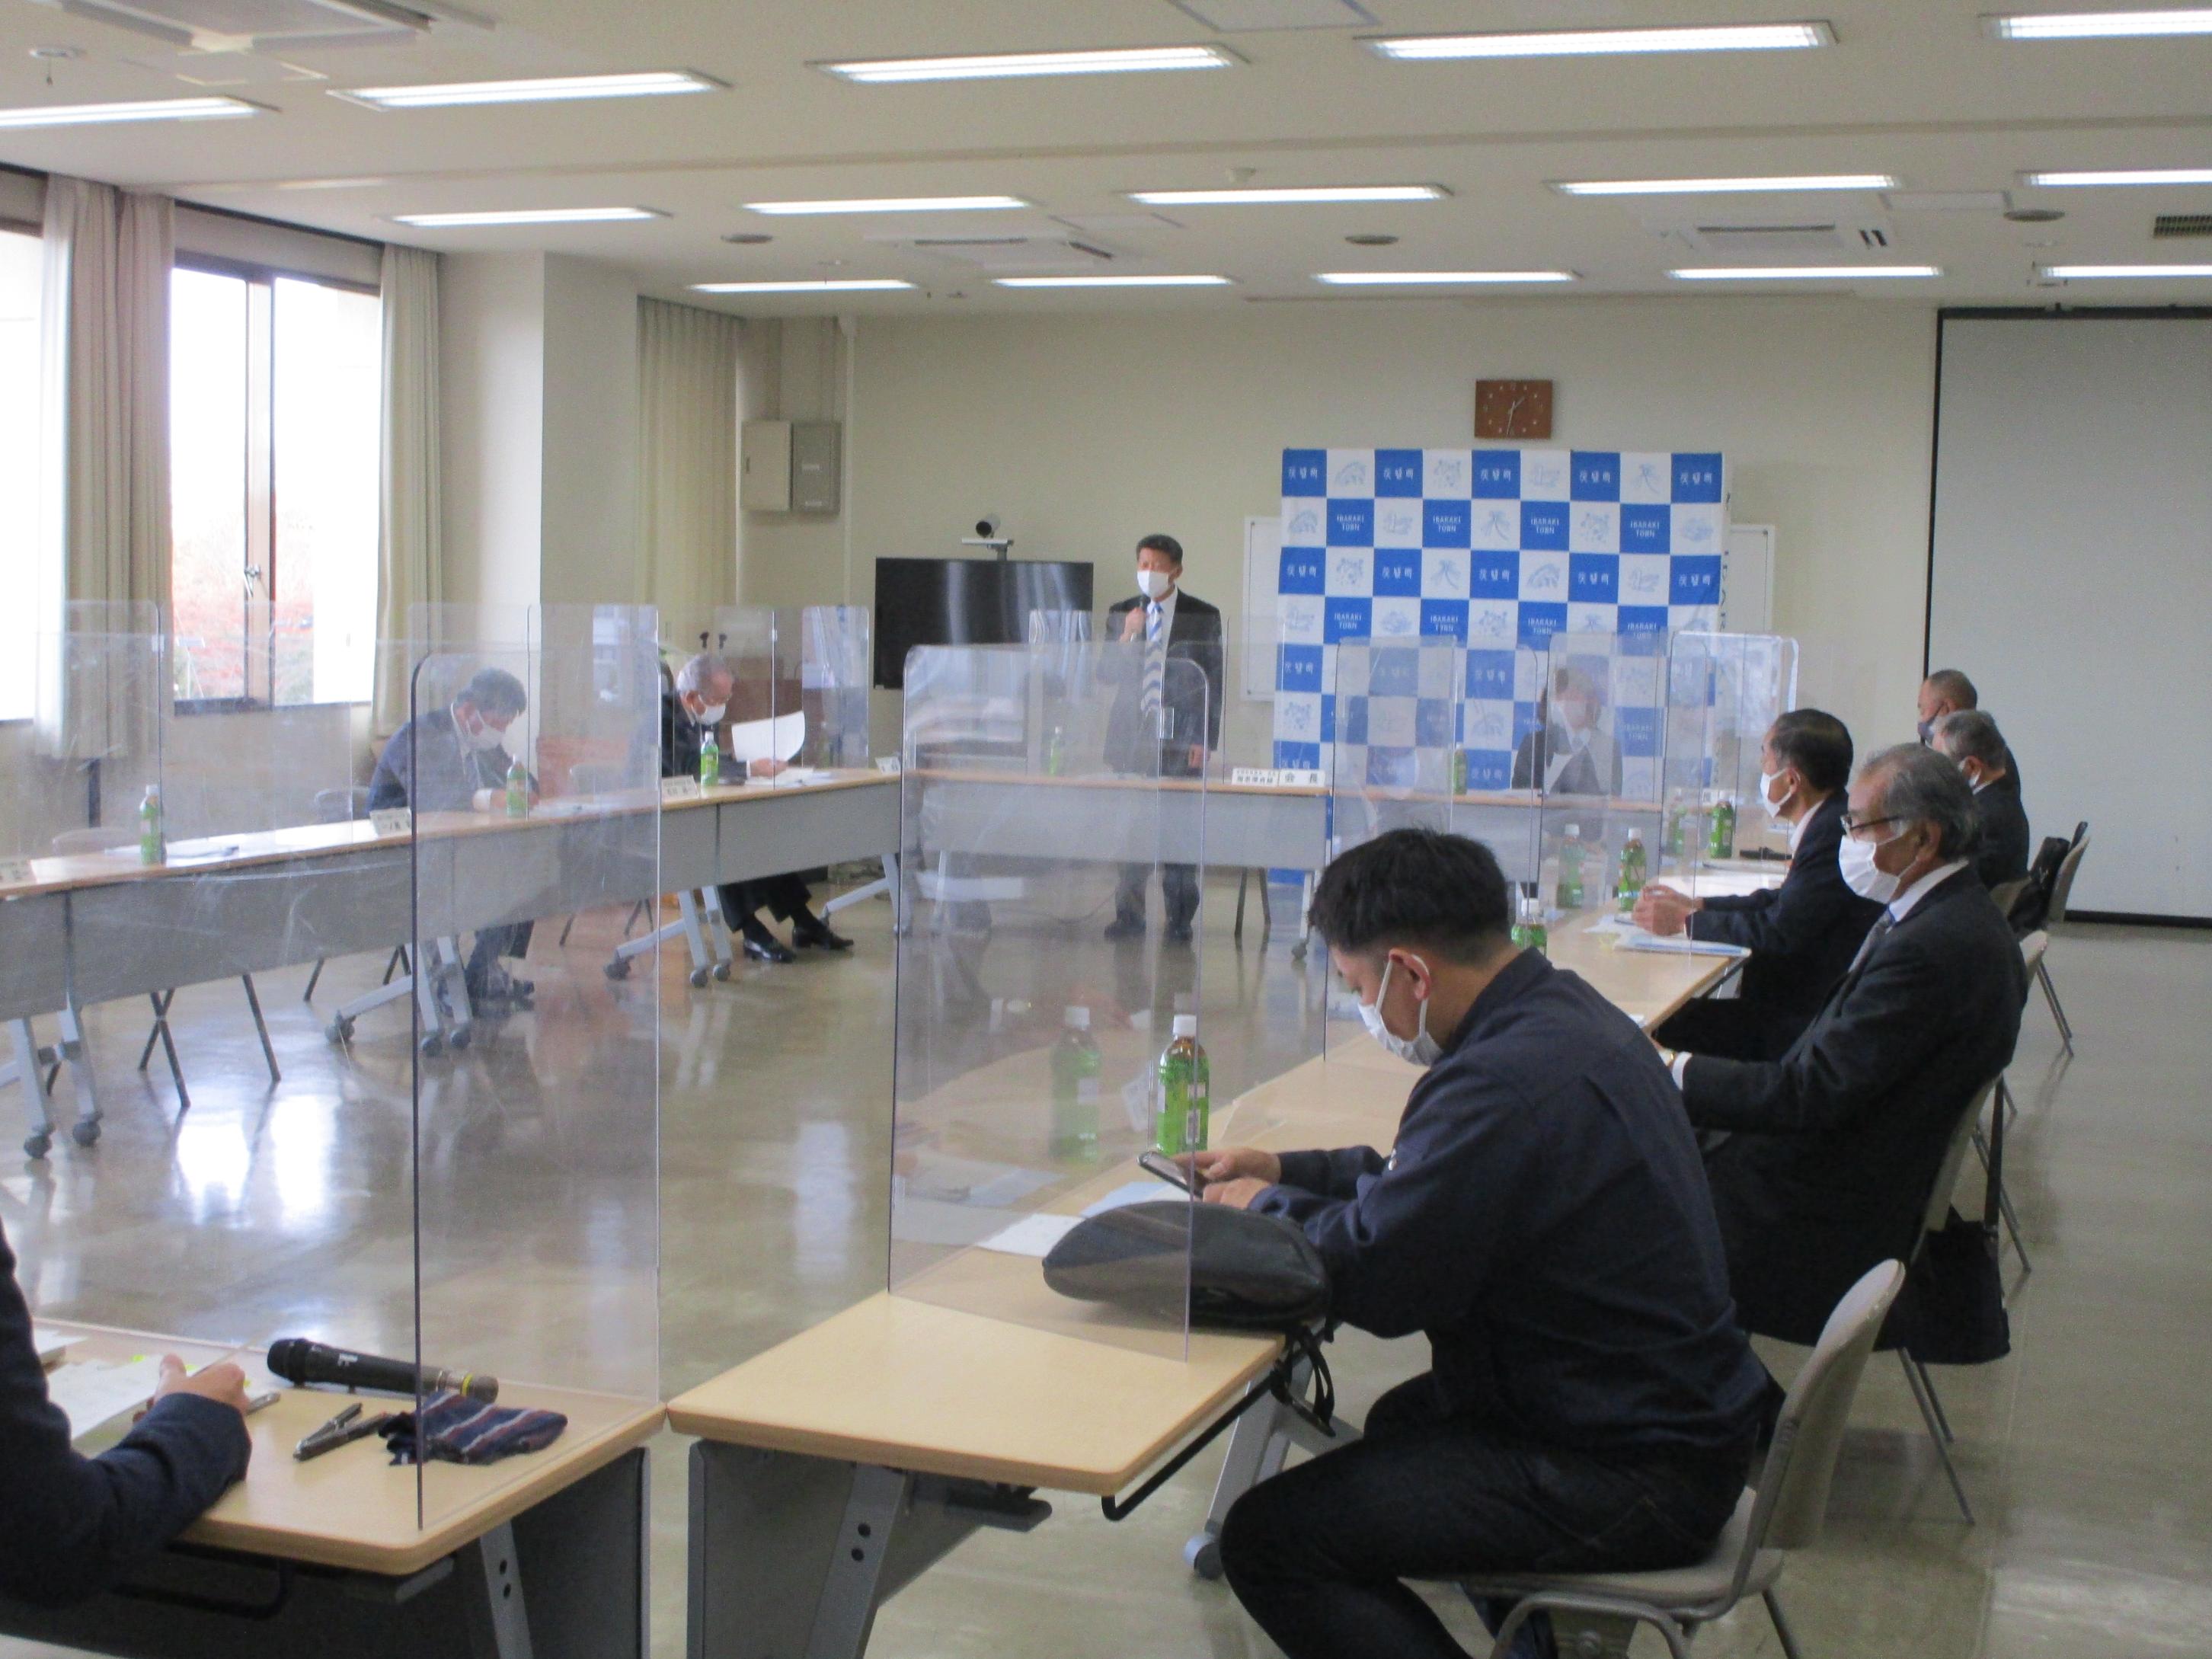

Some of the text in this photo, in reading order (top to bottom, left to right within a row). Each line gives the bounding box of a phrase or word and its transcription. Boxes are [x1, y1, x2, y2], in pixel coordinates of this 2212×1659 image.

[1337, 514, 1364, 523] IBARAKI
[1433, 515, 1461, 523] IBARAKI
[1530, 517, 1559, 526] IBARAKI
[1630, 520, 1660, 529] IBARAKI
